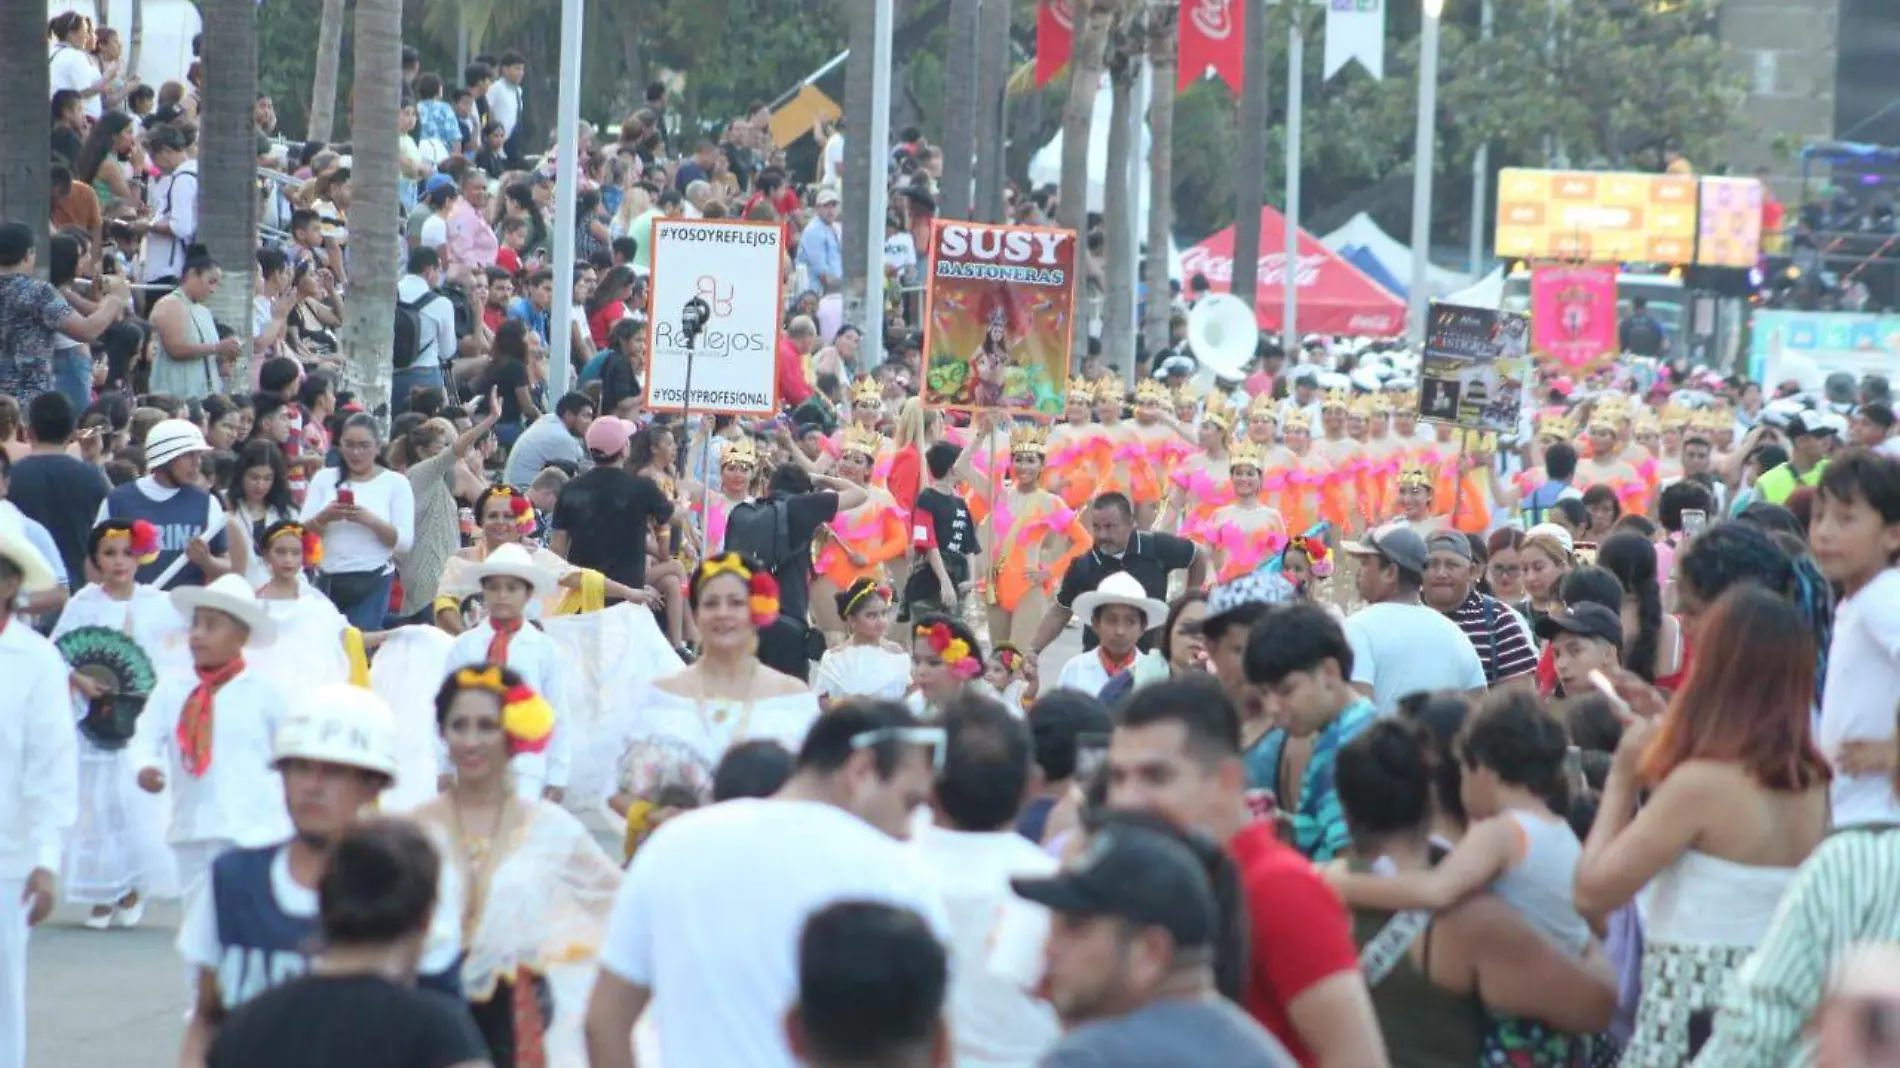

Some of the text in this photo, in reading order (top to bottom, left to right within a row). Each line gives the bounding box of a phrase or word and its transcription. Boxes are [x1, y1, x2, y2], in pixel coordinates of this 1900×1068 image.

[660, 227, 777, 246] #YOSOYREFLEJOS
[940, 224, 1067, 264] SUSY
[937, 260, 1065, 285] BASTONERAS
[655, 321, 764, 357] Relejos
[653, 387, 769, 406] #YOSOYPROFESIONAL
[156, 523, 203, 551] RIN
